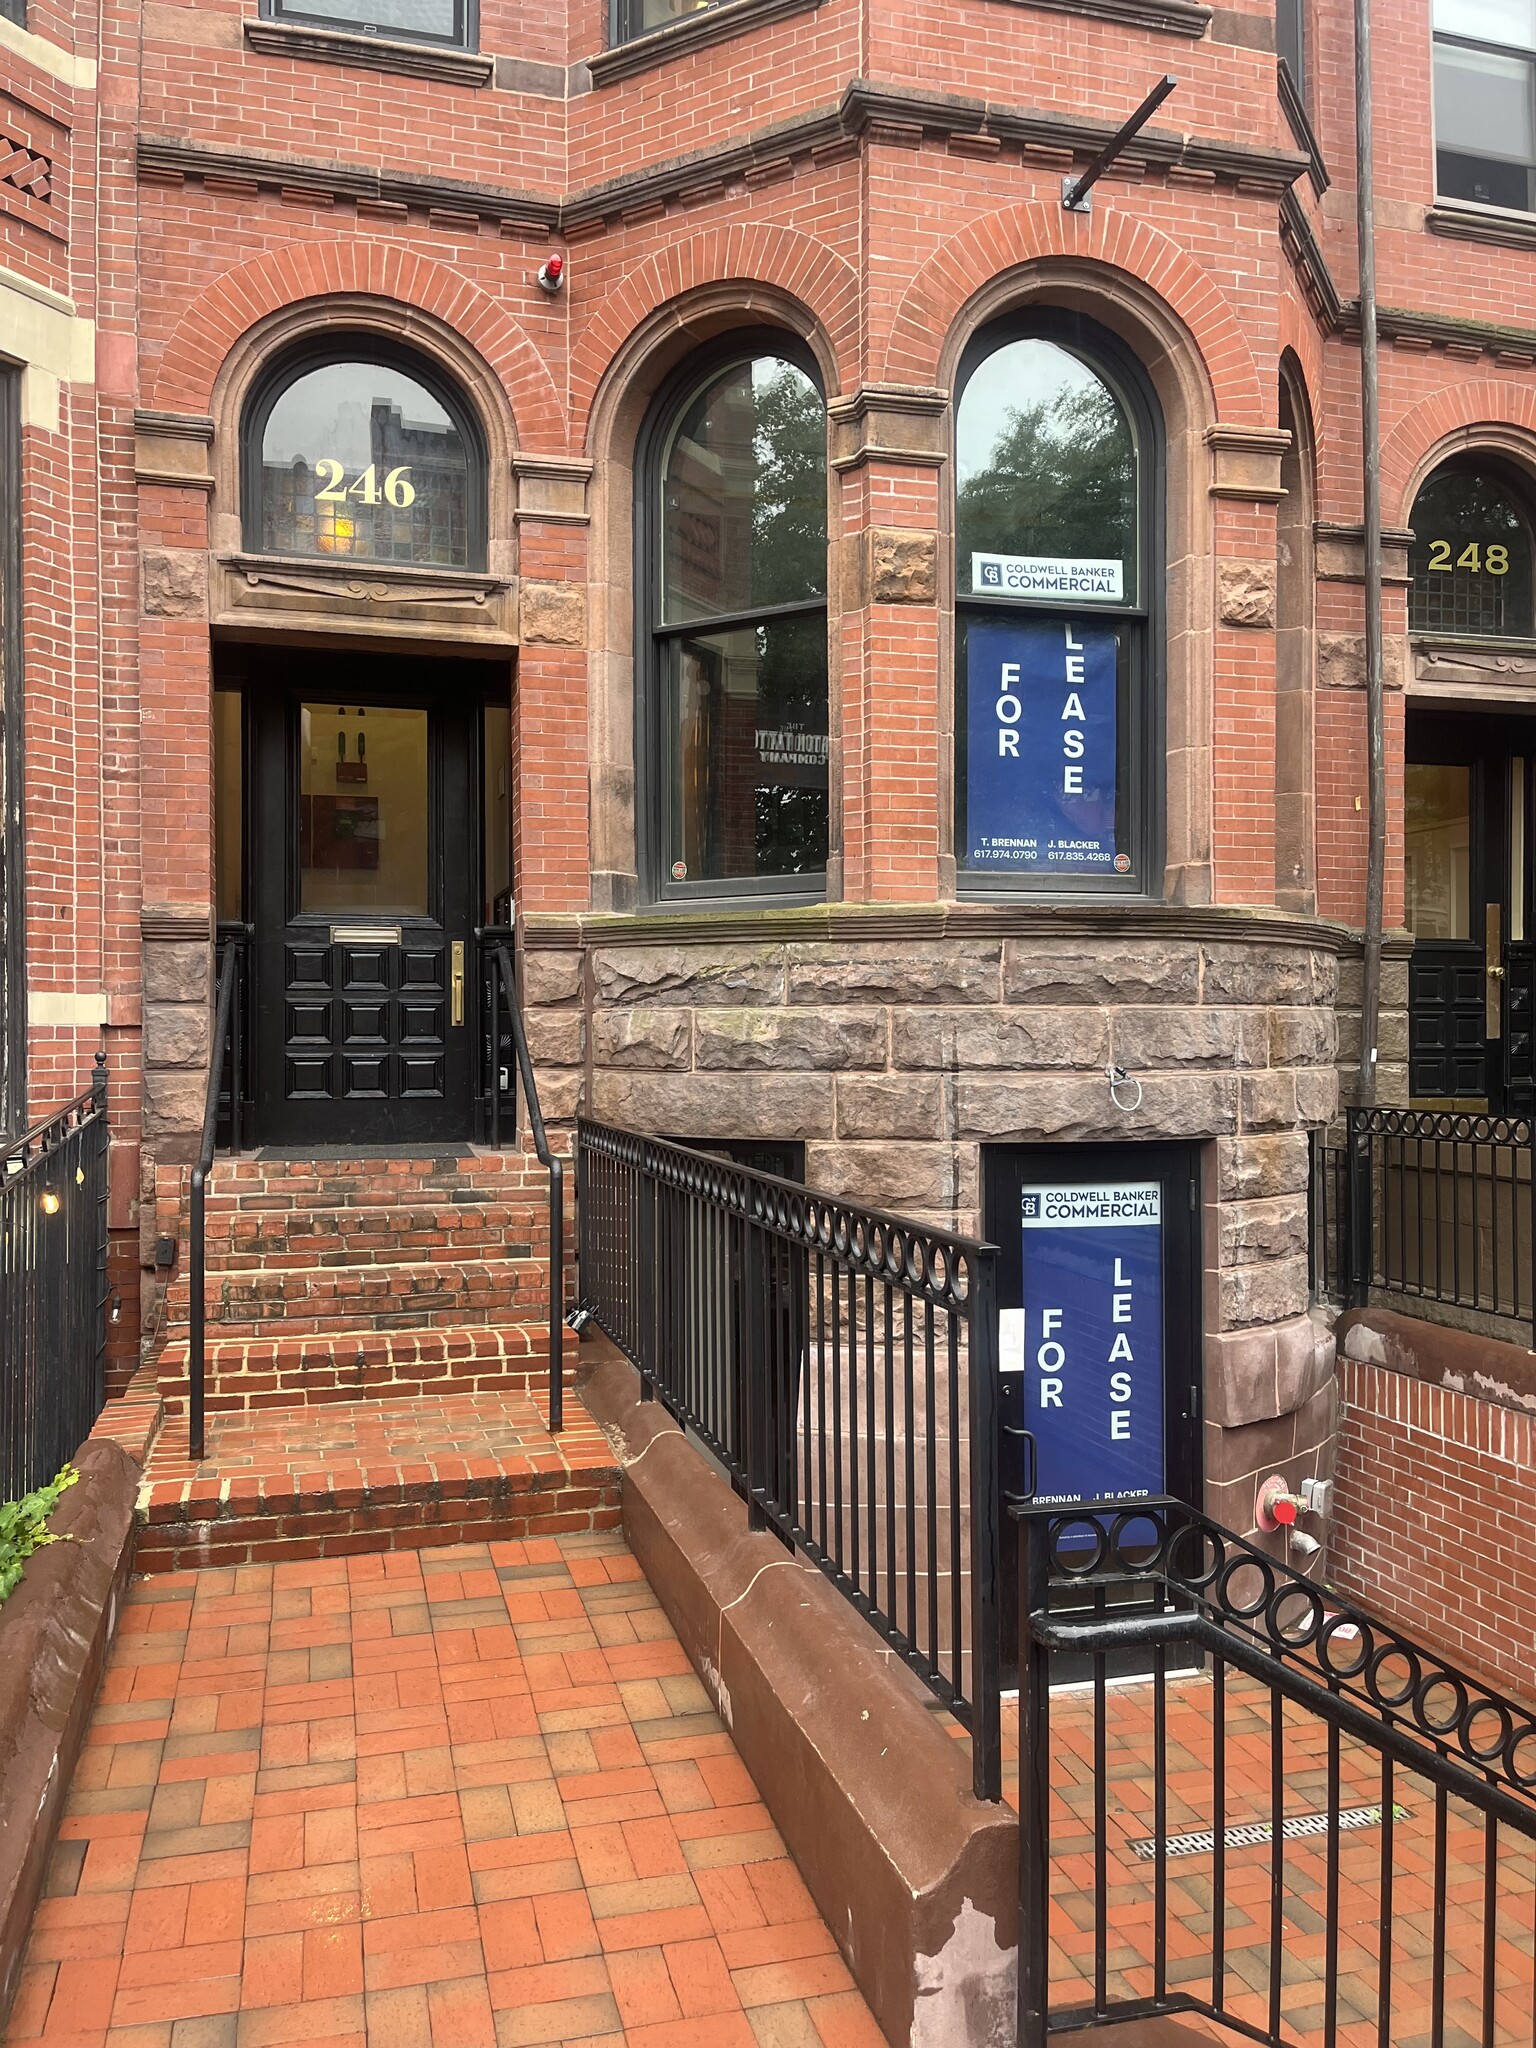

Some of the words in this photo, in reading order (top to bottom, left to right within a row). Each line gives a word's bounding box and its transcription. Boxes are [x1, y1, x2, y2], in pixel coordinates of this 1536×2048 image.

[314, 458, 416, 508] 246
[1427, 539, 1510, 575] 248
[1006, 563, 1068, 576] COLDWELL
[1071, 566, 1115, 578] BANKER
[1007, 575, 1116, 593] COMMERCIAL
[995, 662, 1022, 758] FOR
[1060, 623, 1087, 794] LEASE
[980, 837, 990, 847] T.
[991, 838, 1037, 848] BRENNAN
[1047, 839, 1056, 849] J.
[1058, 840, 1100, 850] BLACKER
[973, 849, 1038, 860] 617.974.0790
[1047, 851, 1111, 862] 617.835.4268
[1045, 1191, 1110, 1203] COLDWELL
[1113, 1190, 1159, 1201] BANKER
[1045, 1203, 1158, 1219] COMMERCIAL
[1107, 1257, 1134, 1440] LEASE
[1036, 1308, 1066, 1408] FOR
[1032, 1494, 1081, 1505] BRENNAN
